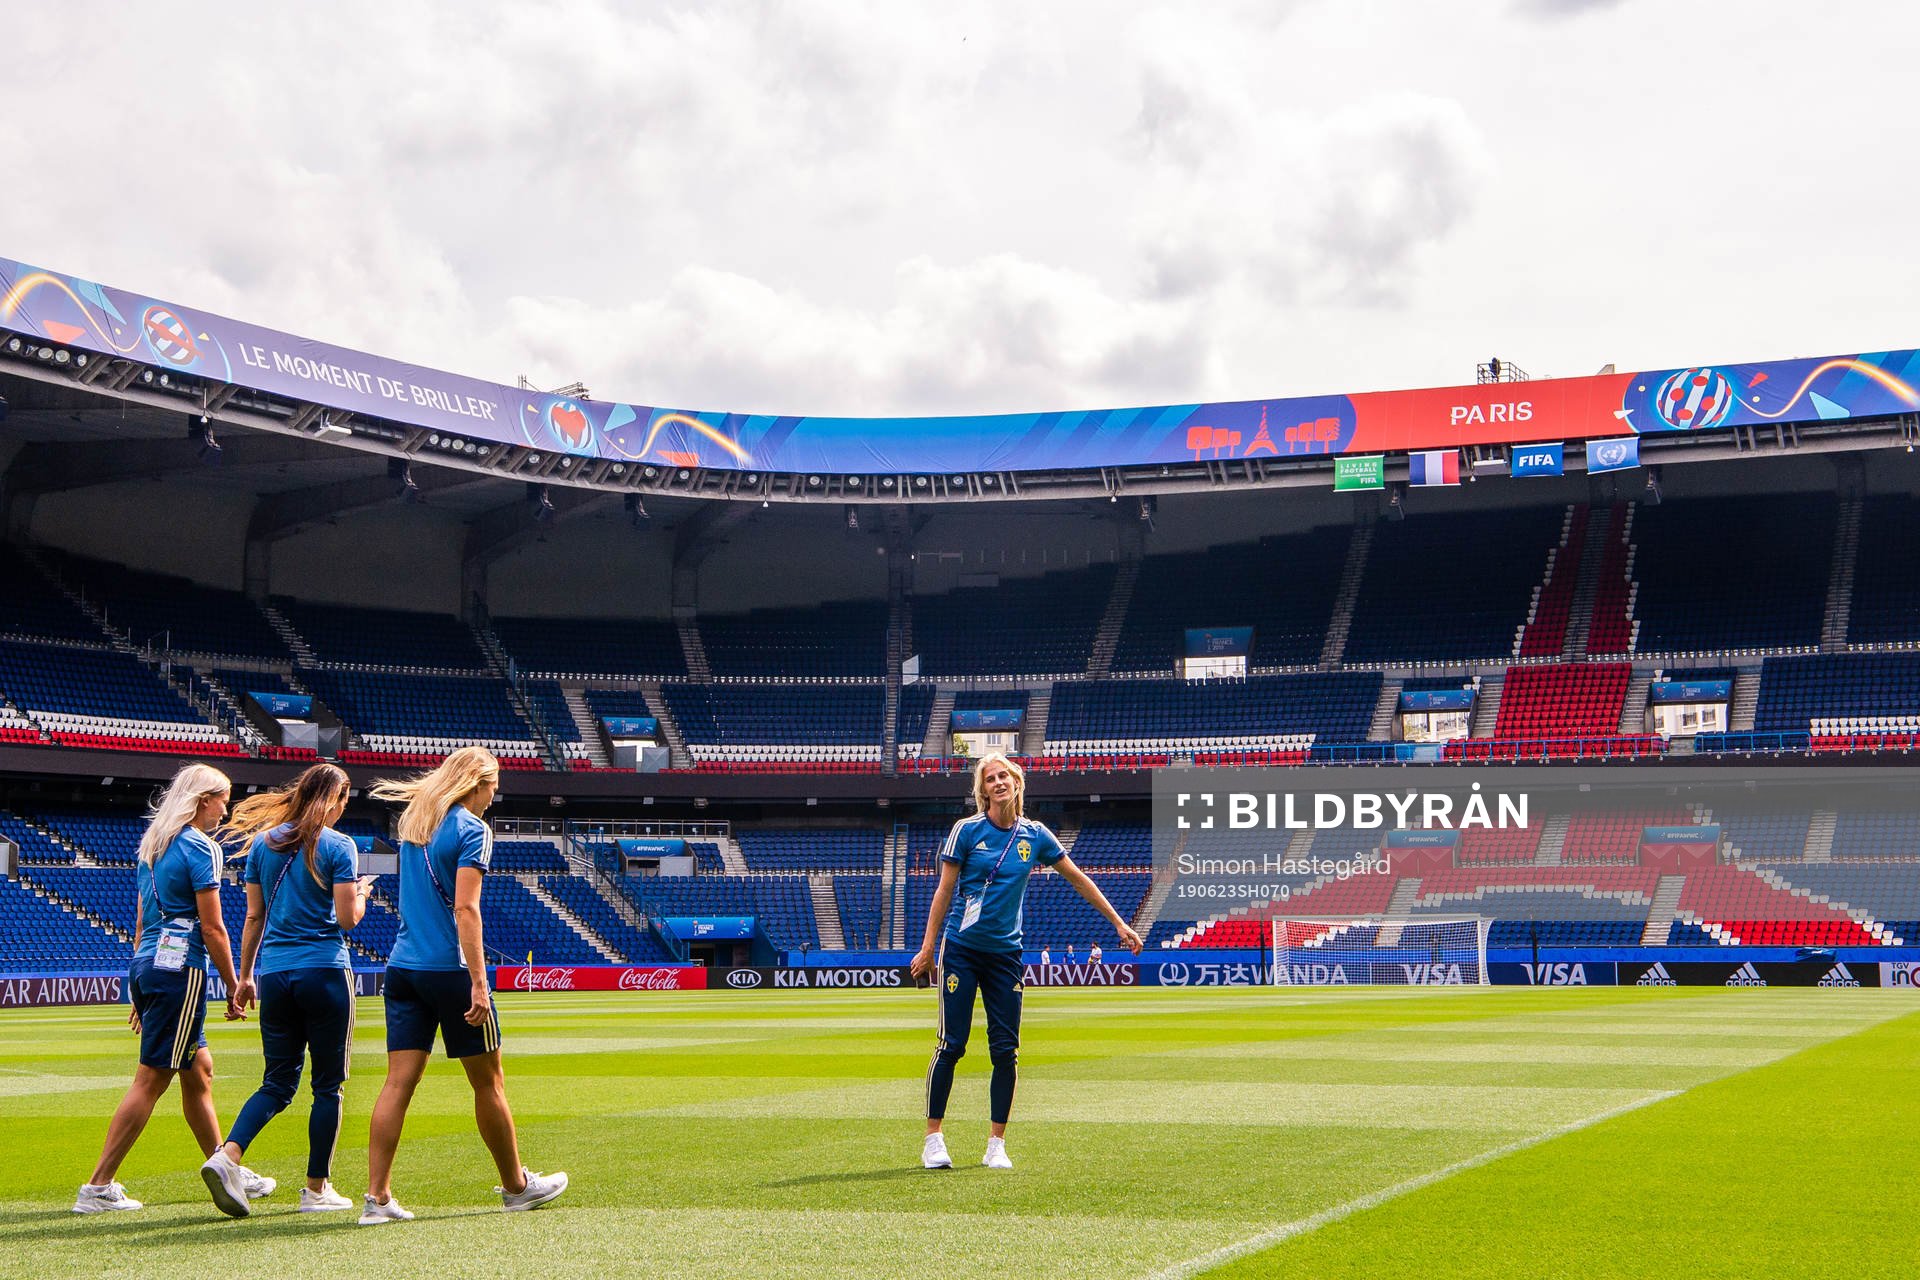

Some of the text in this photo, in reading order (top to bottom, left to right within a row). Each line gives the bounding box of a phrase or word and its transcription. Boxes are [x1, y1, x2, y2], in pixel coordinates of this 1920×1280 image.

[238, 342, 270, 370] LE
[271, 350, 372, 395] MOMENT
[376, 375, 409, 402] DE
[1450, 401, 1534, 426] PARIS
[1518, 453, 1555, 468] FIFA
[1360, 477, 1377, 485] FIFA
[1023, 963, 1135, 985] AIRWAYS
[1250, 963, 1349, 986] WANDA
[1400, 963, 1464, 986] VISA
[1519, 963, 1588, 985] VISA
[1891, 962, 1910, 970] TGV
[513, 967, 576, 990] Coca-Cola
[618, 968, 681, 990] Coca-Cola
[732, 973, 756, 985] KIA
[774, 968, 901, 987] KIA MOTORS
[1636, 977, 1677, 987] adidas
[1725, 977, 1767, 988] adidas
[1818, 977, 1860, 988] adidas
[36, 976, 121, 1004] AIRWAYS
